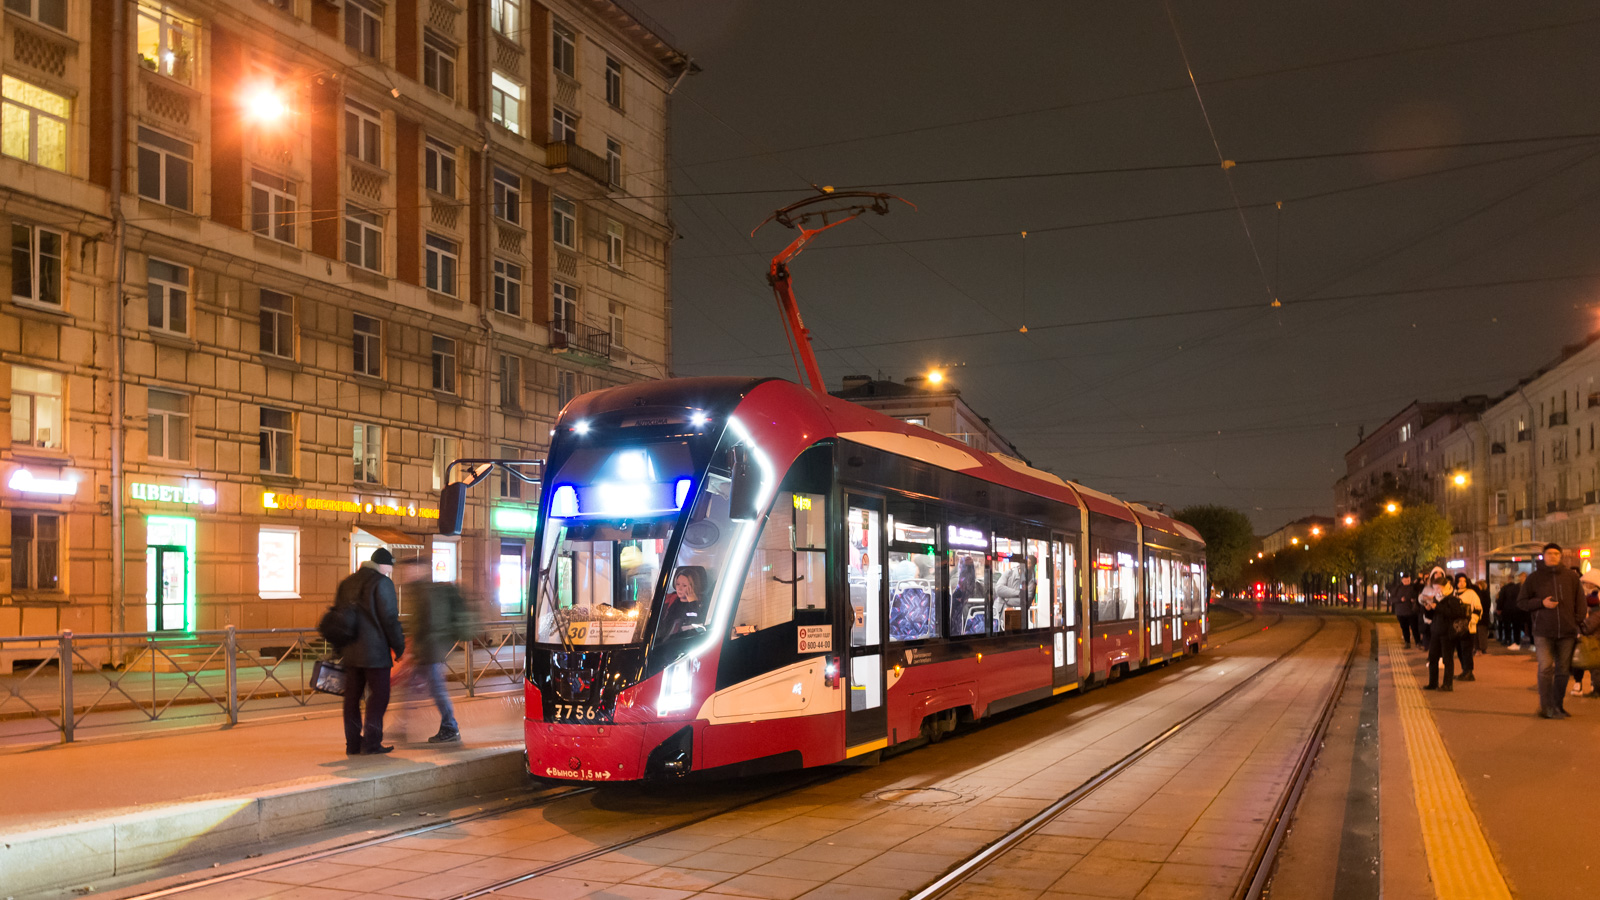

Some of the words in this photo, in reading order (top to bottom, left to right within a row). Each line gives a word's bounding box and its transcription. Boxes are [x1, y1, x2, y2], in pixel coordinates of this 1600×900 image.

[131, 482, 199, 505] ЦВЕТЫ
[306, 498, 363, 514] ЮВЕЛИРНЫЙ
[570, 627, 587, 639] 30
[555, 704, 595, 720] 7756
[552, 767, 579, 778] Вынос
[581, 769, 593, 779] 1,5
